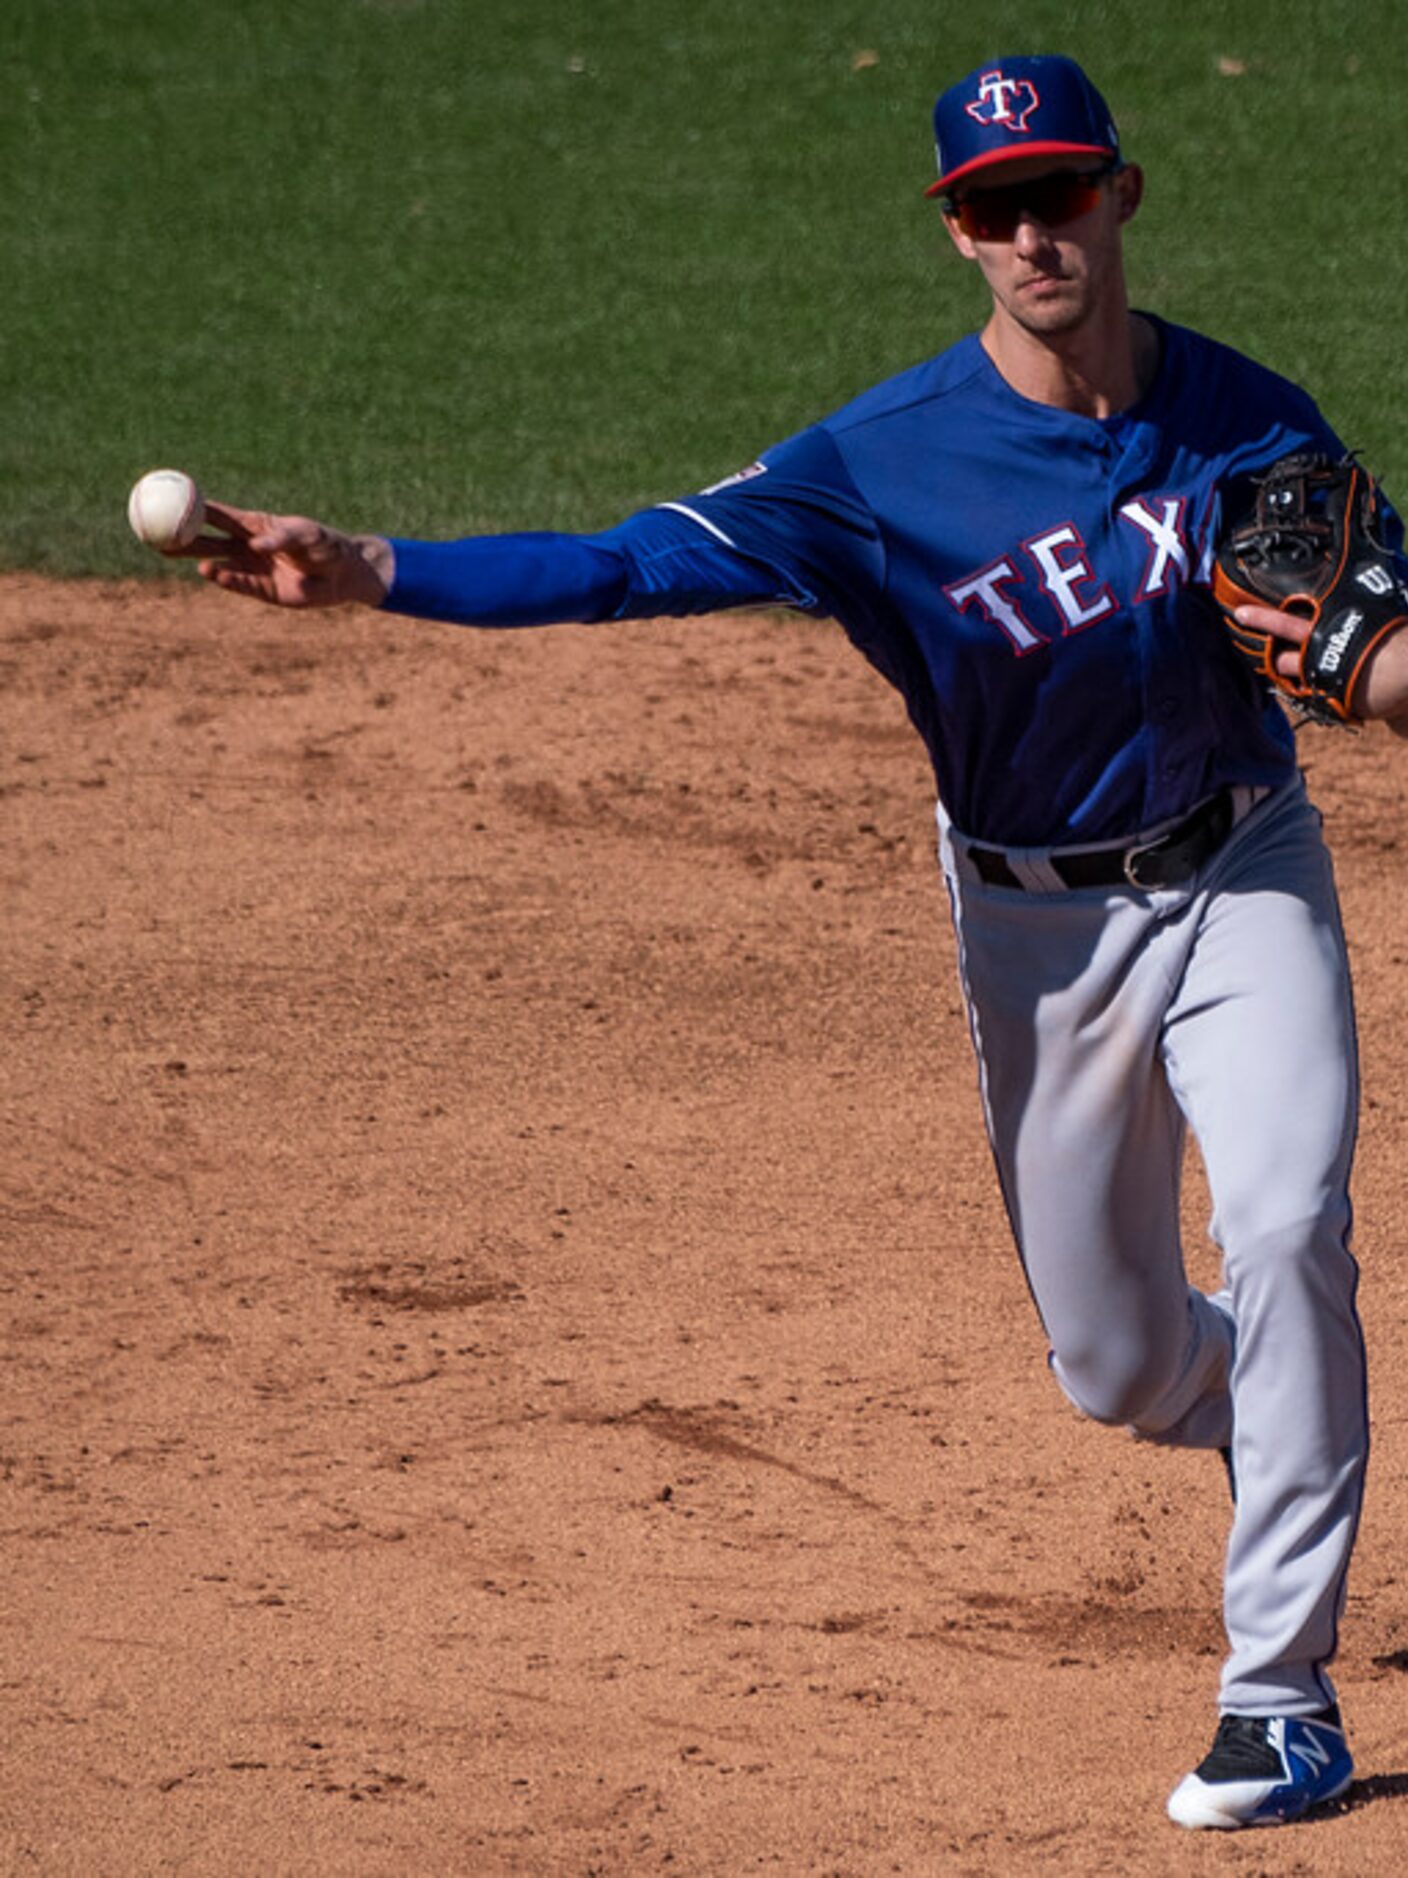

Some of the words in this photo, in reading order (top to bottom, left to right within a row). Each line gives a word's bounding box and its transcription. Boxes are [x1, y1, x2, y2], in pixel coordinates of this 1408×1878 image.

[978, 77, 1017, 122] T
[942, 484, 1214, 657] TEX
[1318, 609, 1363, 672] Wilson
